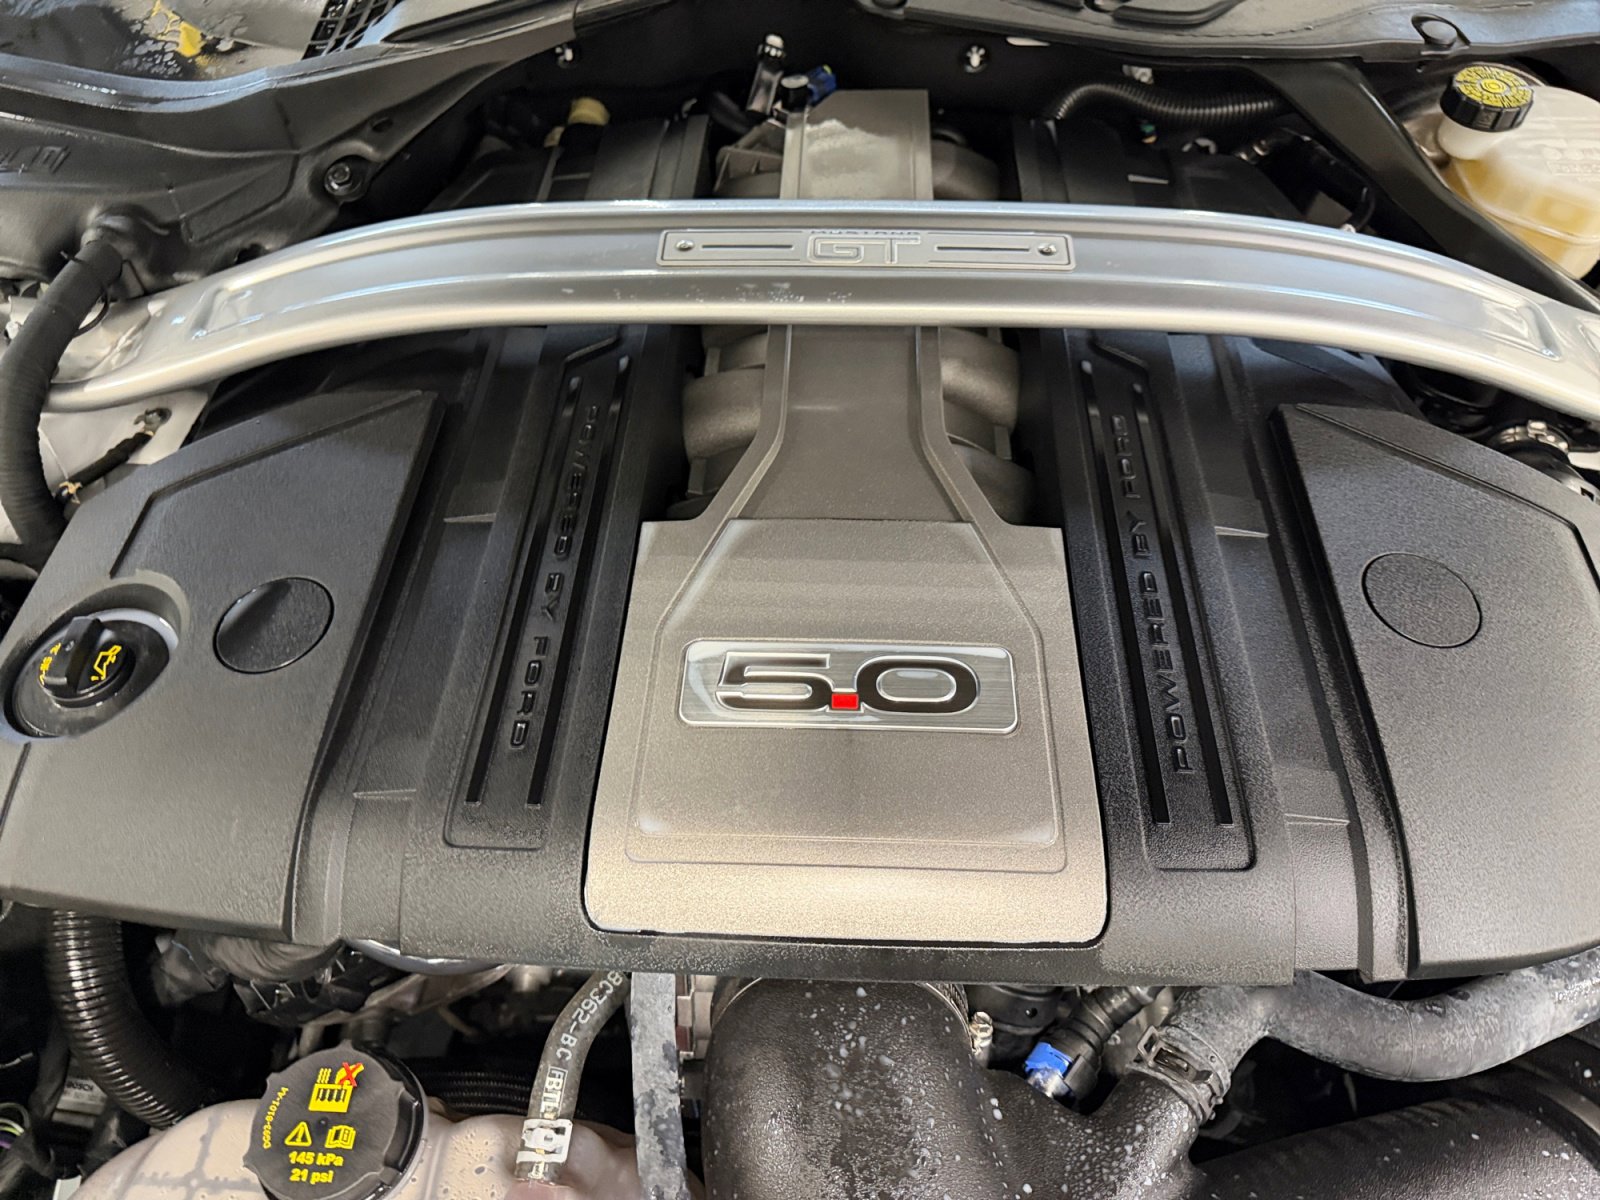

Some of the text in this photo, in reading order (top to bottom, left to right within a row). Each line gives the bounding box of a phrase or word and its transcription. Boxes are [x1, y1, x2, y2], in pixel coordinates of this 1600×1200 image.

[807, 235, 921, 264] GT
[543, 572, 563, 621] BY
[1111, 414, 1194, 774] POWERED BY FORD
[510, 635, 549, 749] FORD
[715, 651, 979, 714] 5.0
[288, 1151, 344, 1166] 145 kPa
[289, 1168, 334, 1185] 21 psi
